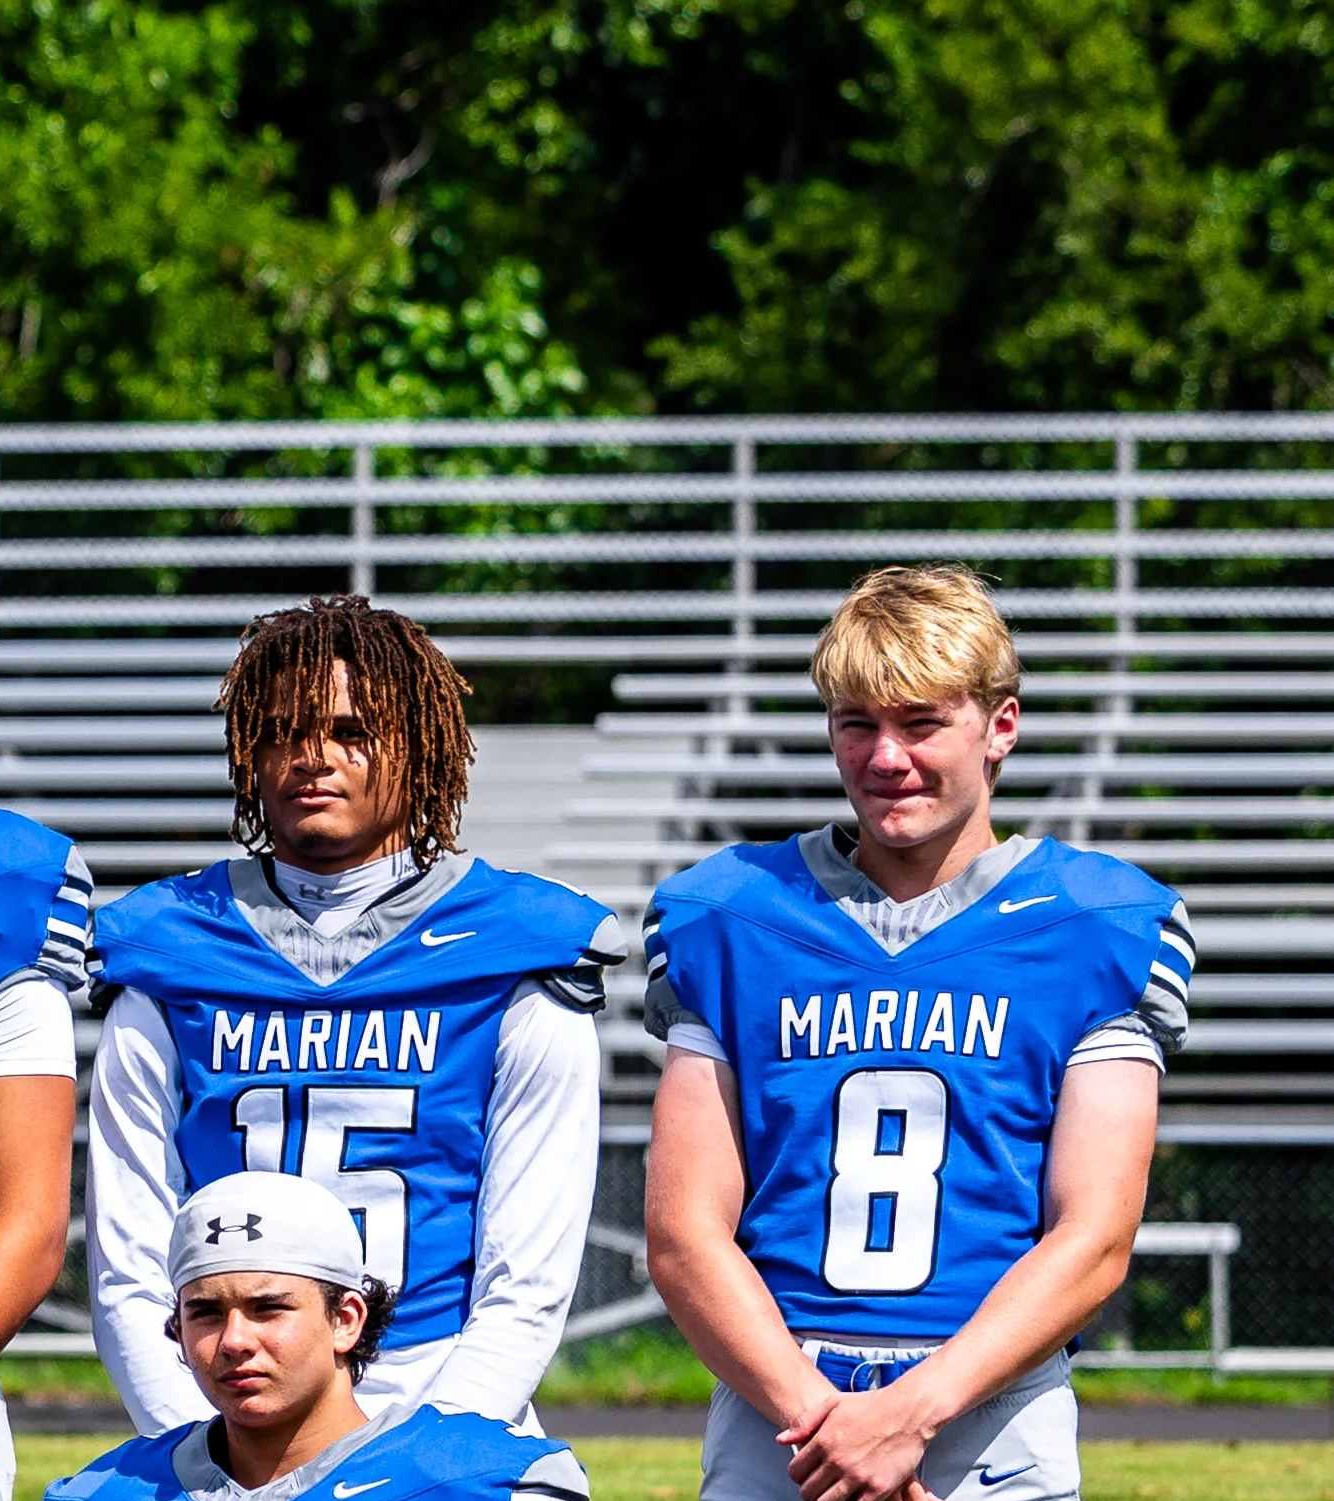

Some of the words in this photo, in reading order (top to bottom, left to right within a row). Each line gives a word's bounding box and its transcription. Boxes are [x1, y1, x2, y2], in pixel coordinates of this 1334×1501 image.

[211, 1009, 442, 1073] MARIAN
[779, 989, 1010, 1059] MARIAN
[822, 1069, 948, 1292] 8
